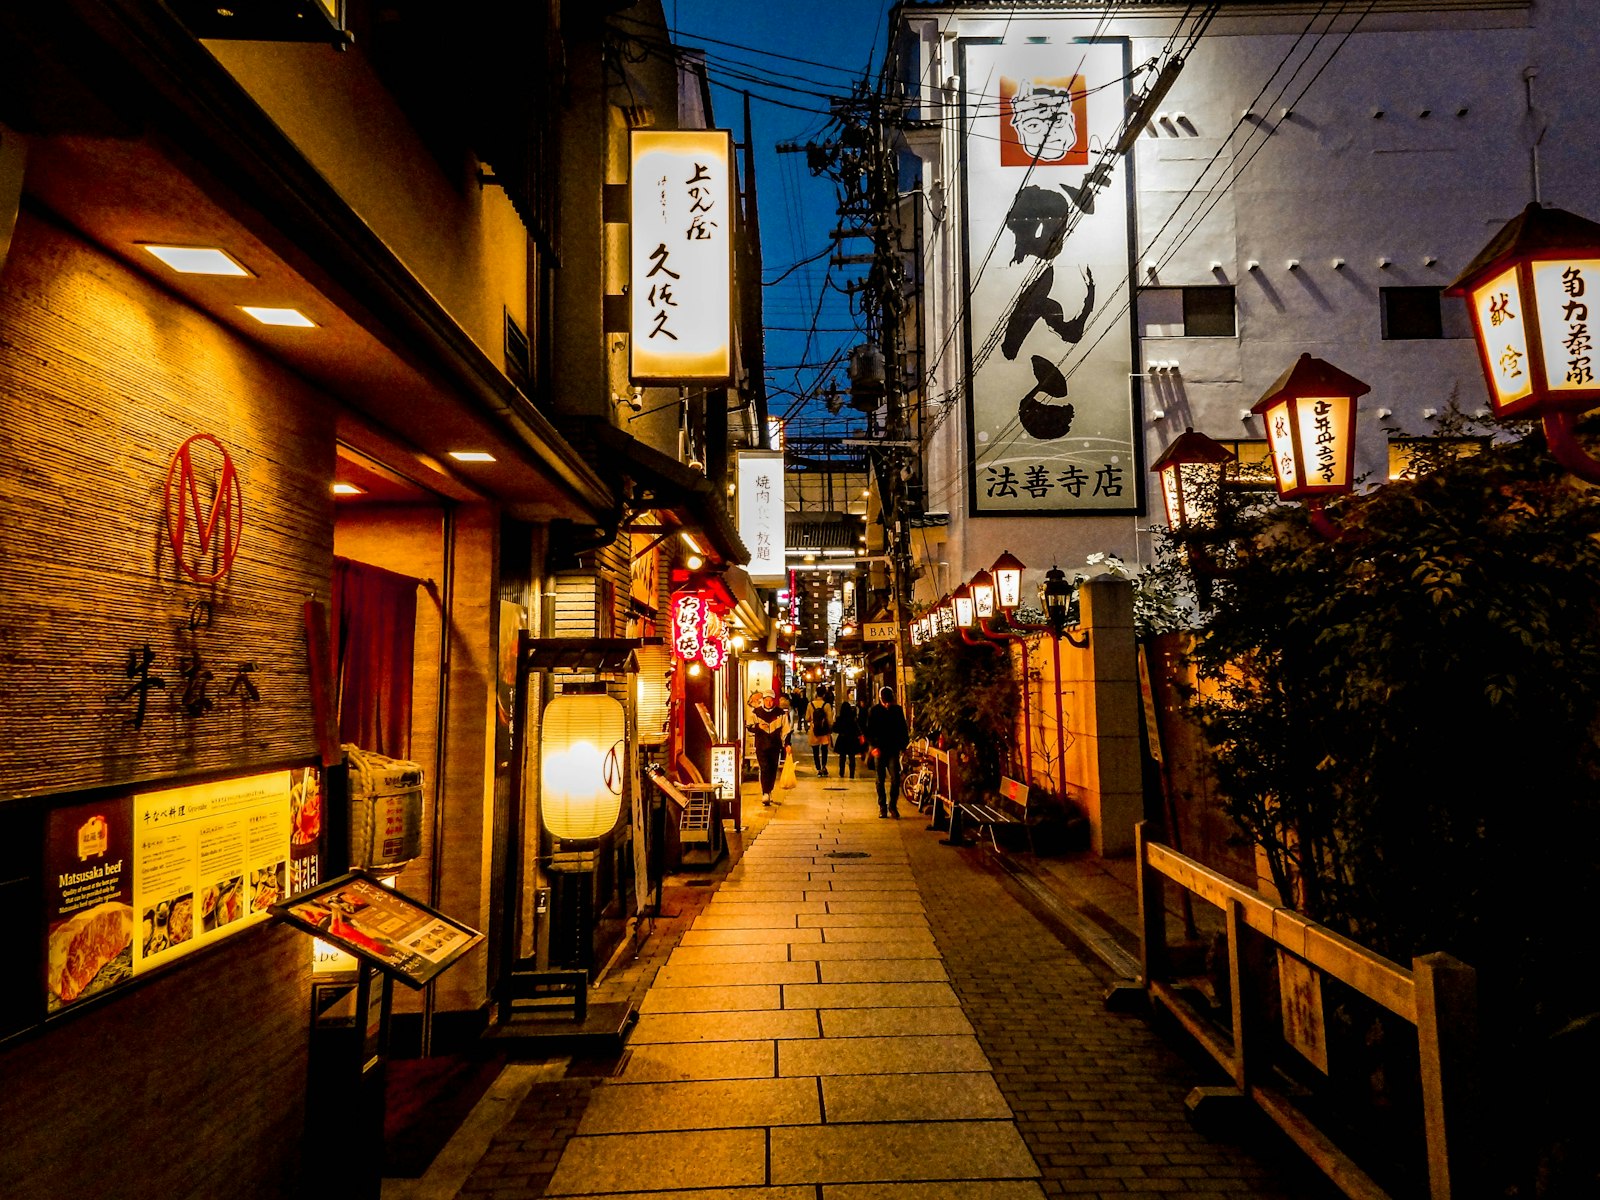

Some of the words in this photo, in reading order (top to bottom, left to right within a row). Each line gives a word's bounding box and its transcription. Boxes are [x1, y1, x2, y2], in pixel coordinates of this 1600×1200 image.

[646, 243, 680, 341] 久佐久
[984, 463, 1124, 500] 法善寺店
[677, 596, 700, 658] お好み焼き
[869, 627, 895, 637] BAR
[58, 866, 104, 888] Matsusaka
[104, 859, 123, 876] beef
